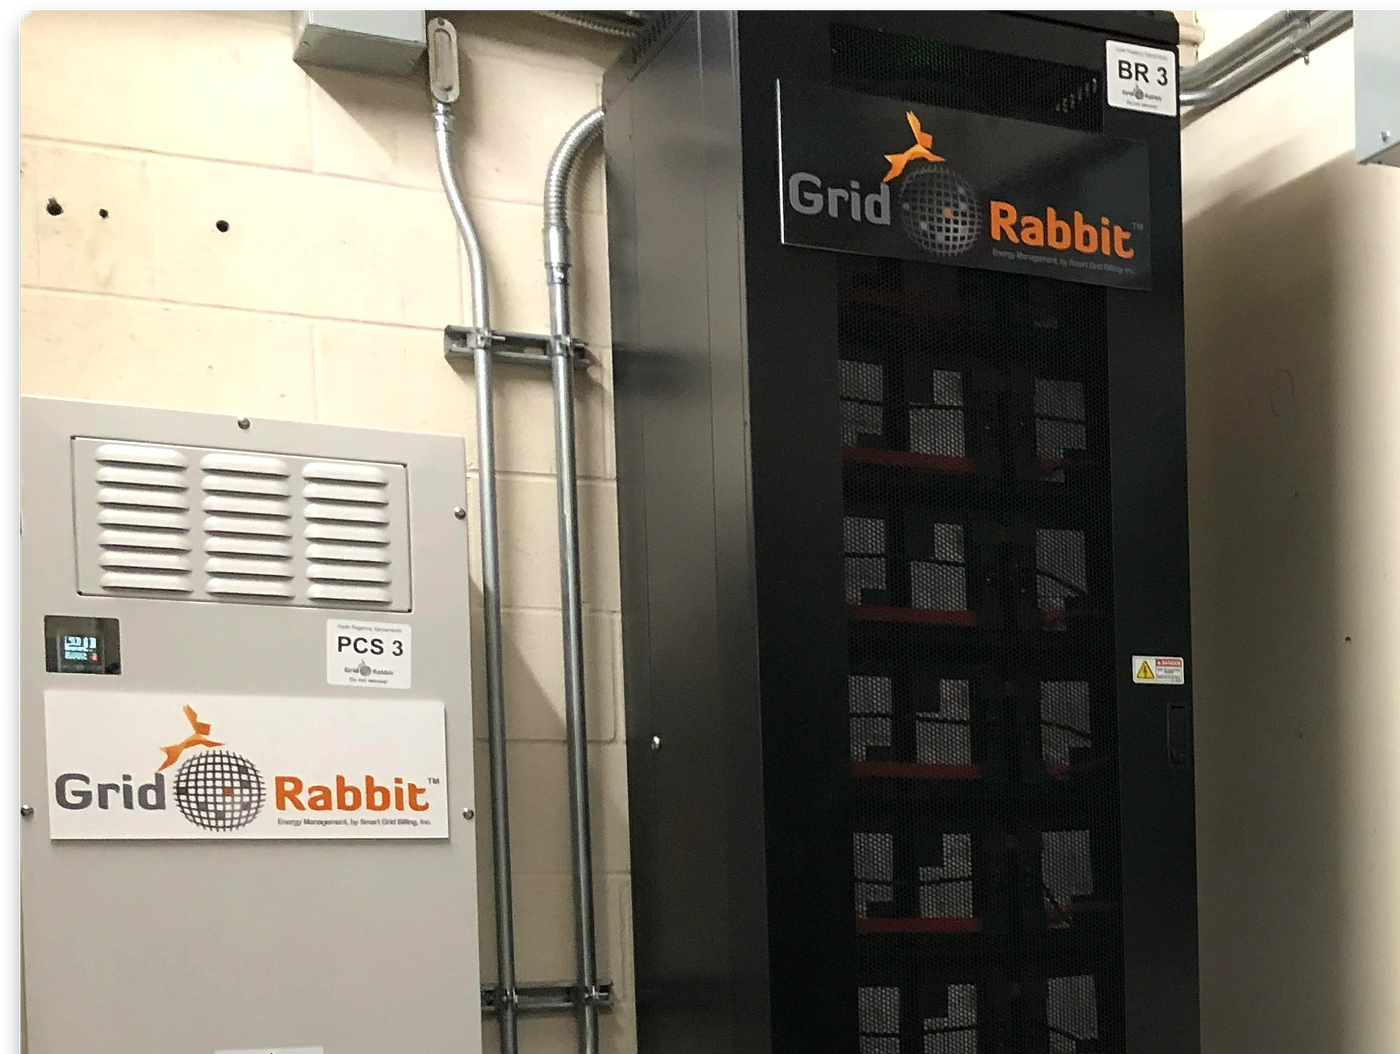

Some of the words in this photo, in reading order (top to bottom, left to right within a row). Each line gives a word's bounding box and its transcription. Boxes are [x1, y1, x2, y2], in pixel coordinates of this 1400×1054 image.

[1118, 59, 1149, 83] BR
[1157, 66, 1168, 86] 3
[789, 172, 890, 226] Grid
[990, 200, 1135, 259] Rabbit
[338, 636, 384, 655] PCS
[392, 640, 403, 656] 3
[55, 772, 166, 811] Grid
[275, 774, 430, 812] Rabbit
